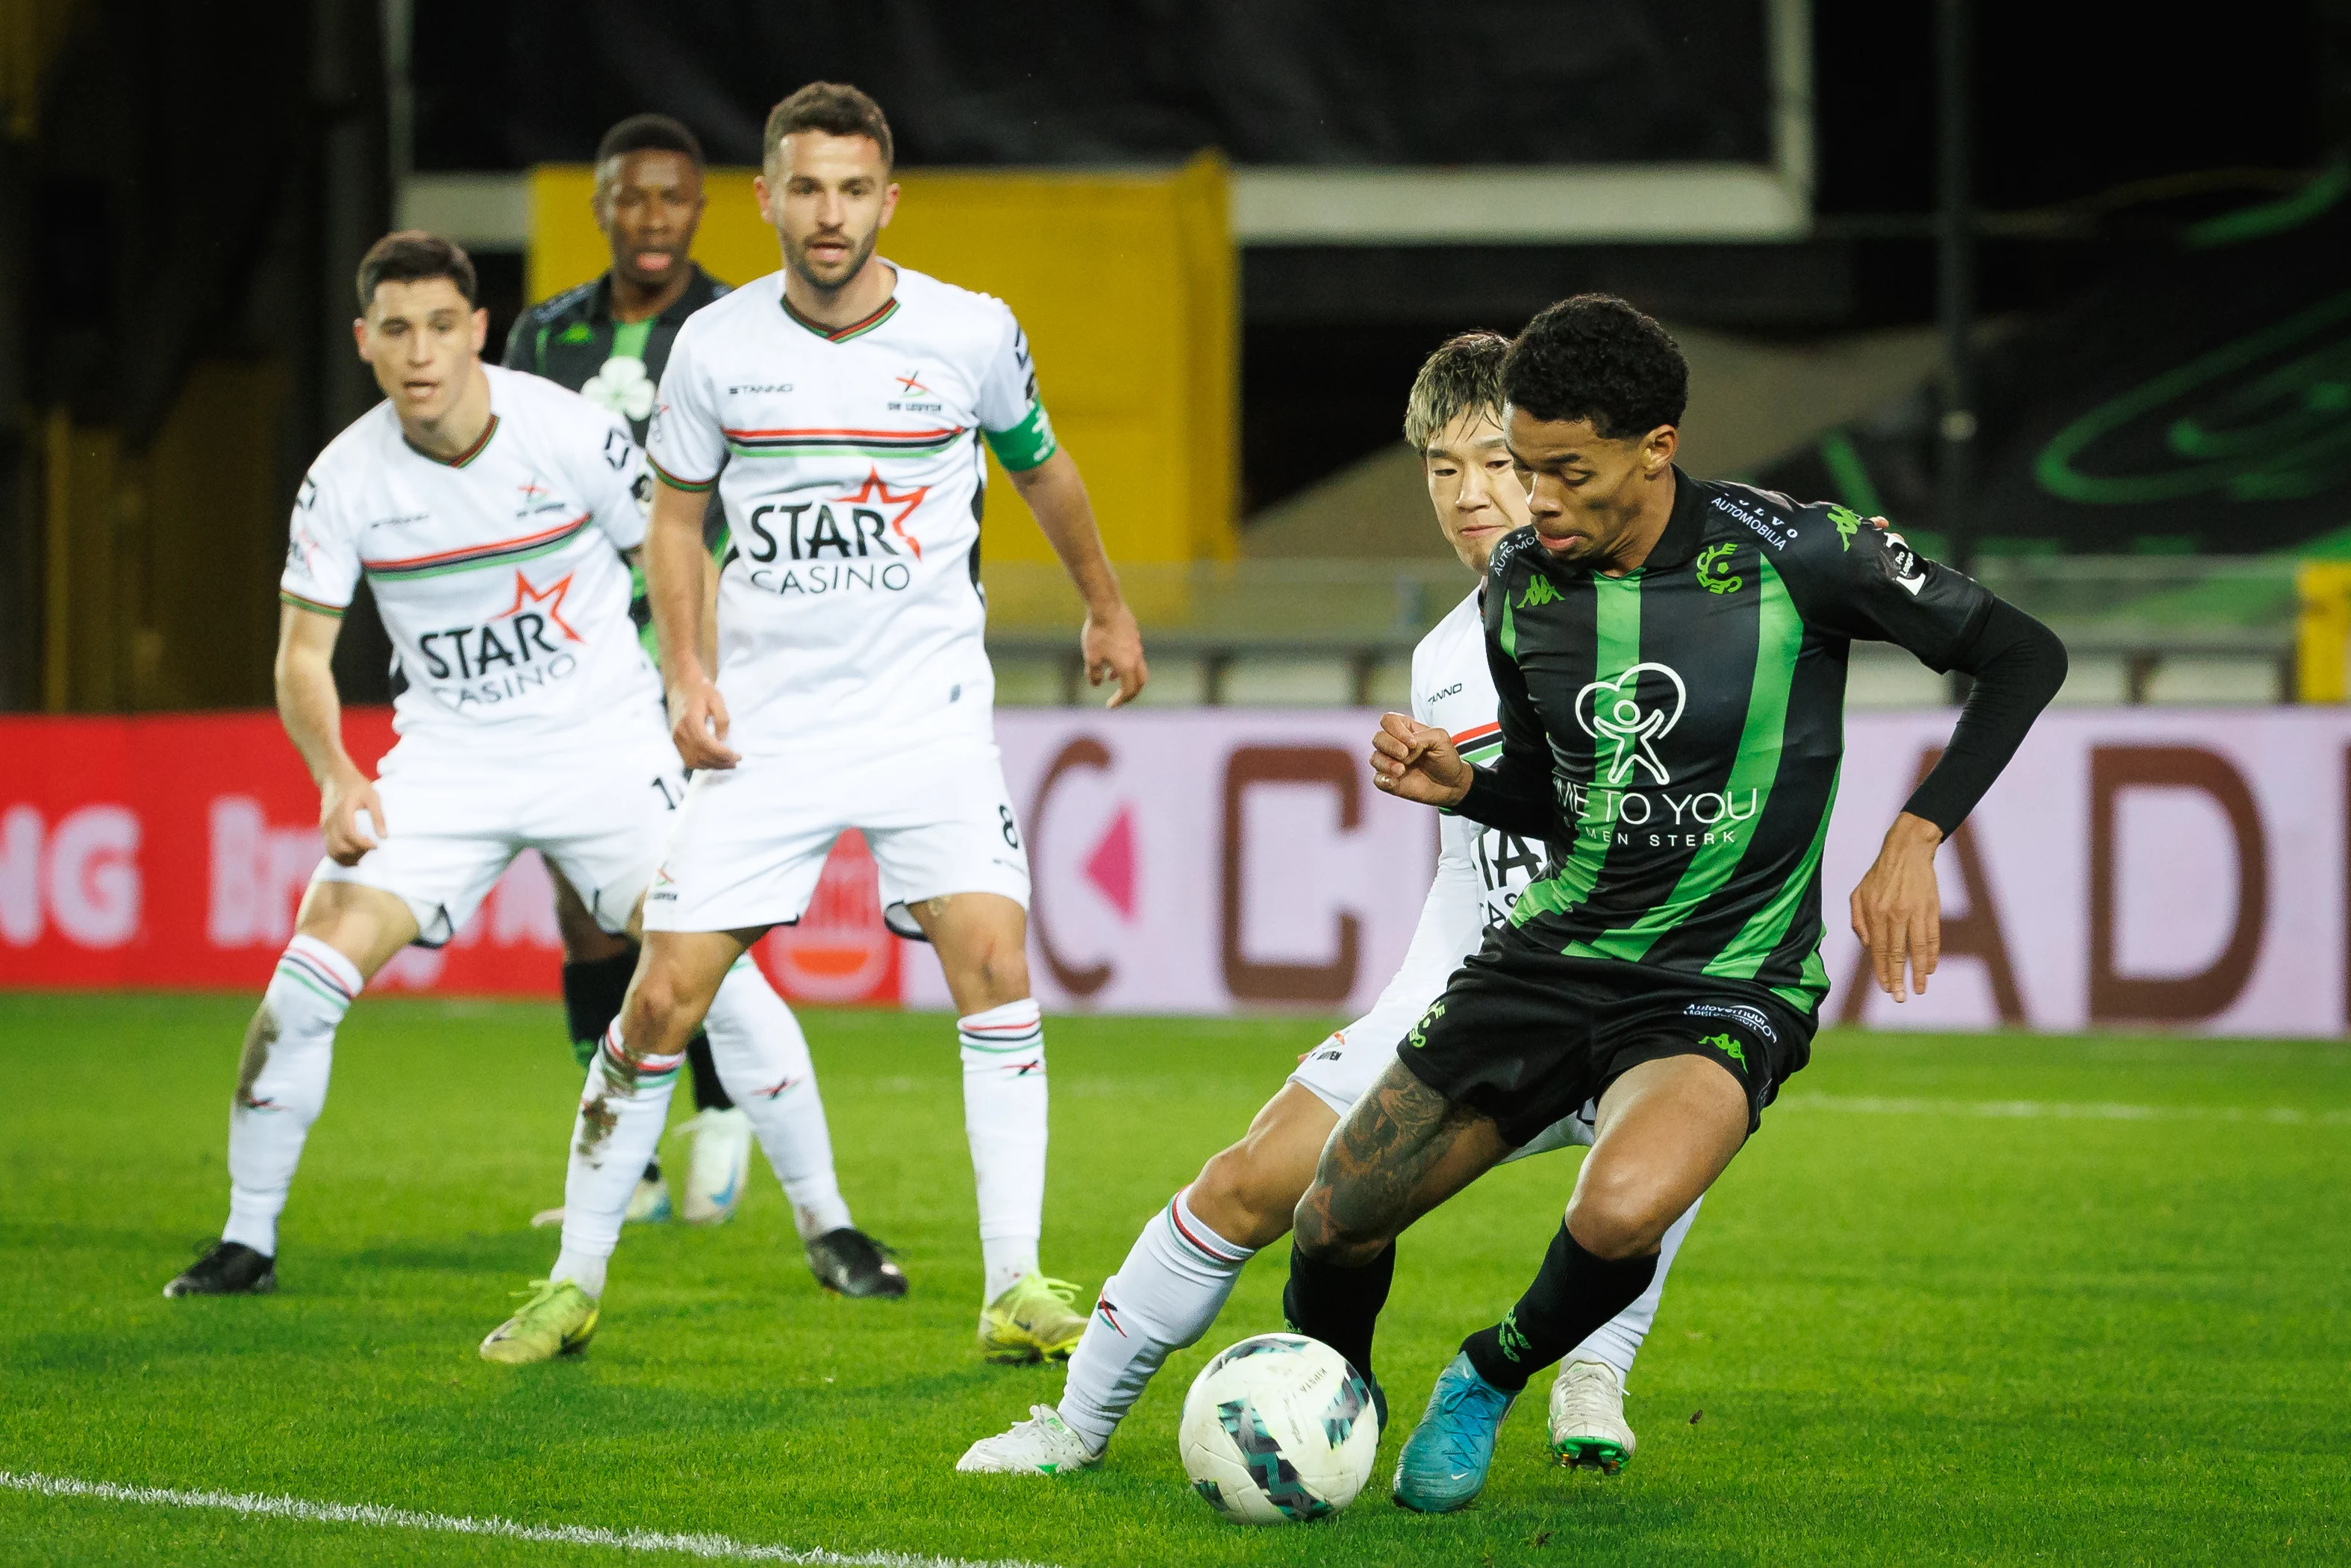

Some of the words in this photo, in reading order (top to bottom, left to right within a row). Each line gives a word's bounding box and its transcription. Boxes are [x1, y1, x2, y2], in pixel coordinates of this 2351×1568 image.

[750, 501, 900, 563] STAR
[1711, 497, 1787, 552] AUTOMOBILIA
[1895, 552, 1905, 565] Pro
[751, 563, 910, 595] CASINO
[420, 613, 559, 681] STAR
[1427, 683, 1462, 707] TANNO
[1600, 789, 1651, 825] TO
[1662, 788, 1757, 825] YOU
[999, 805, 1018, 849] 8
[1649, 831, 1735, 847] STERK
